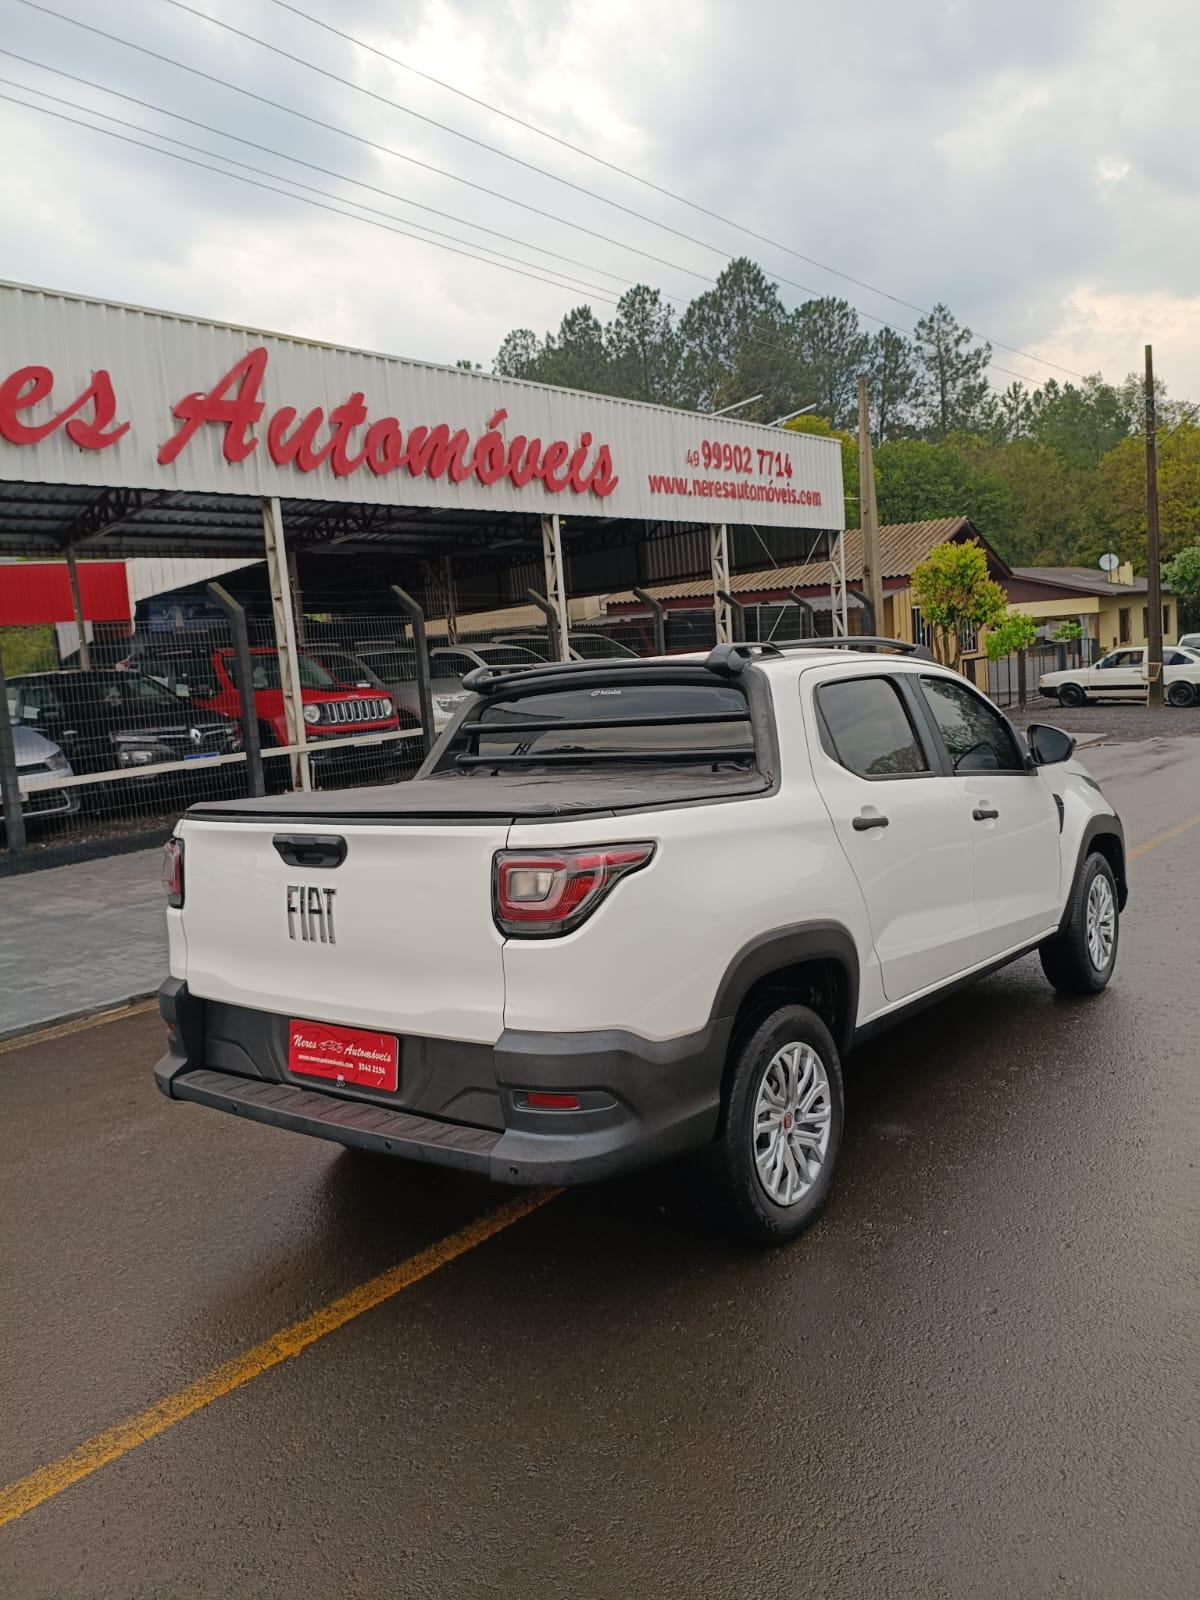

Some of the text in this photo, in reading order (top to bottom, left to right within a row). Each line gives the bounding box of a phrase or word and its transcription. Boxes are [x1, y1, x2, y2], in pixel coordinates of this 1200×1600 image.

[157, 347, 619, 497] Automóveis
[686, 440, 794, 479] 49 99902 7714
[648, 474, 822, 506] www.neresautomóveis.com
[287, 885, 336, 944] FIAT
[293, 1034, 391, 1062] Neres Automóveis
